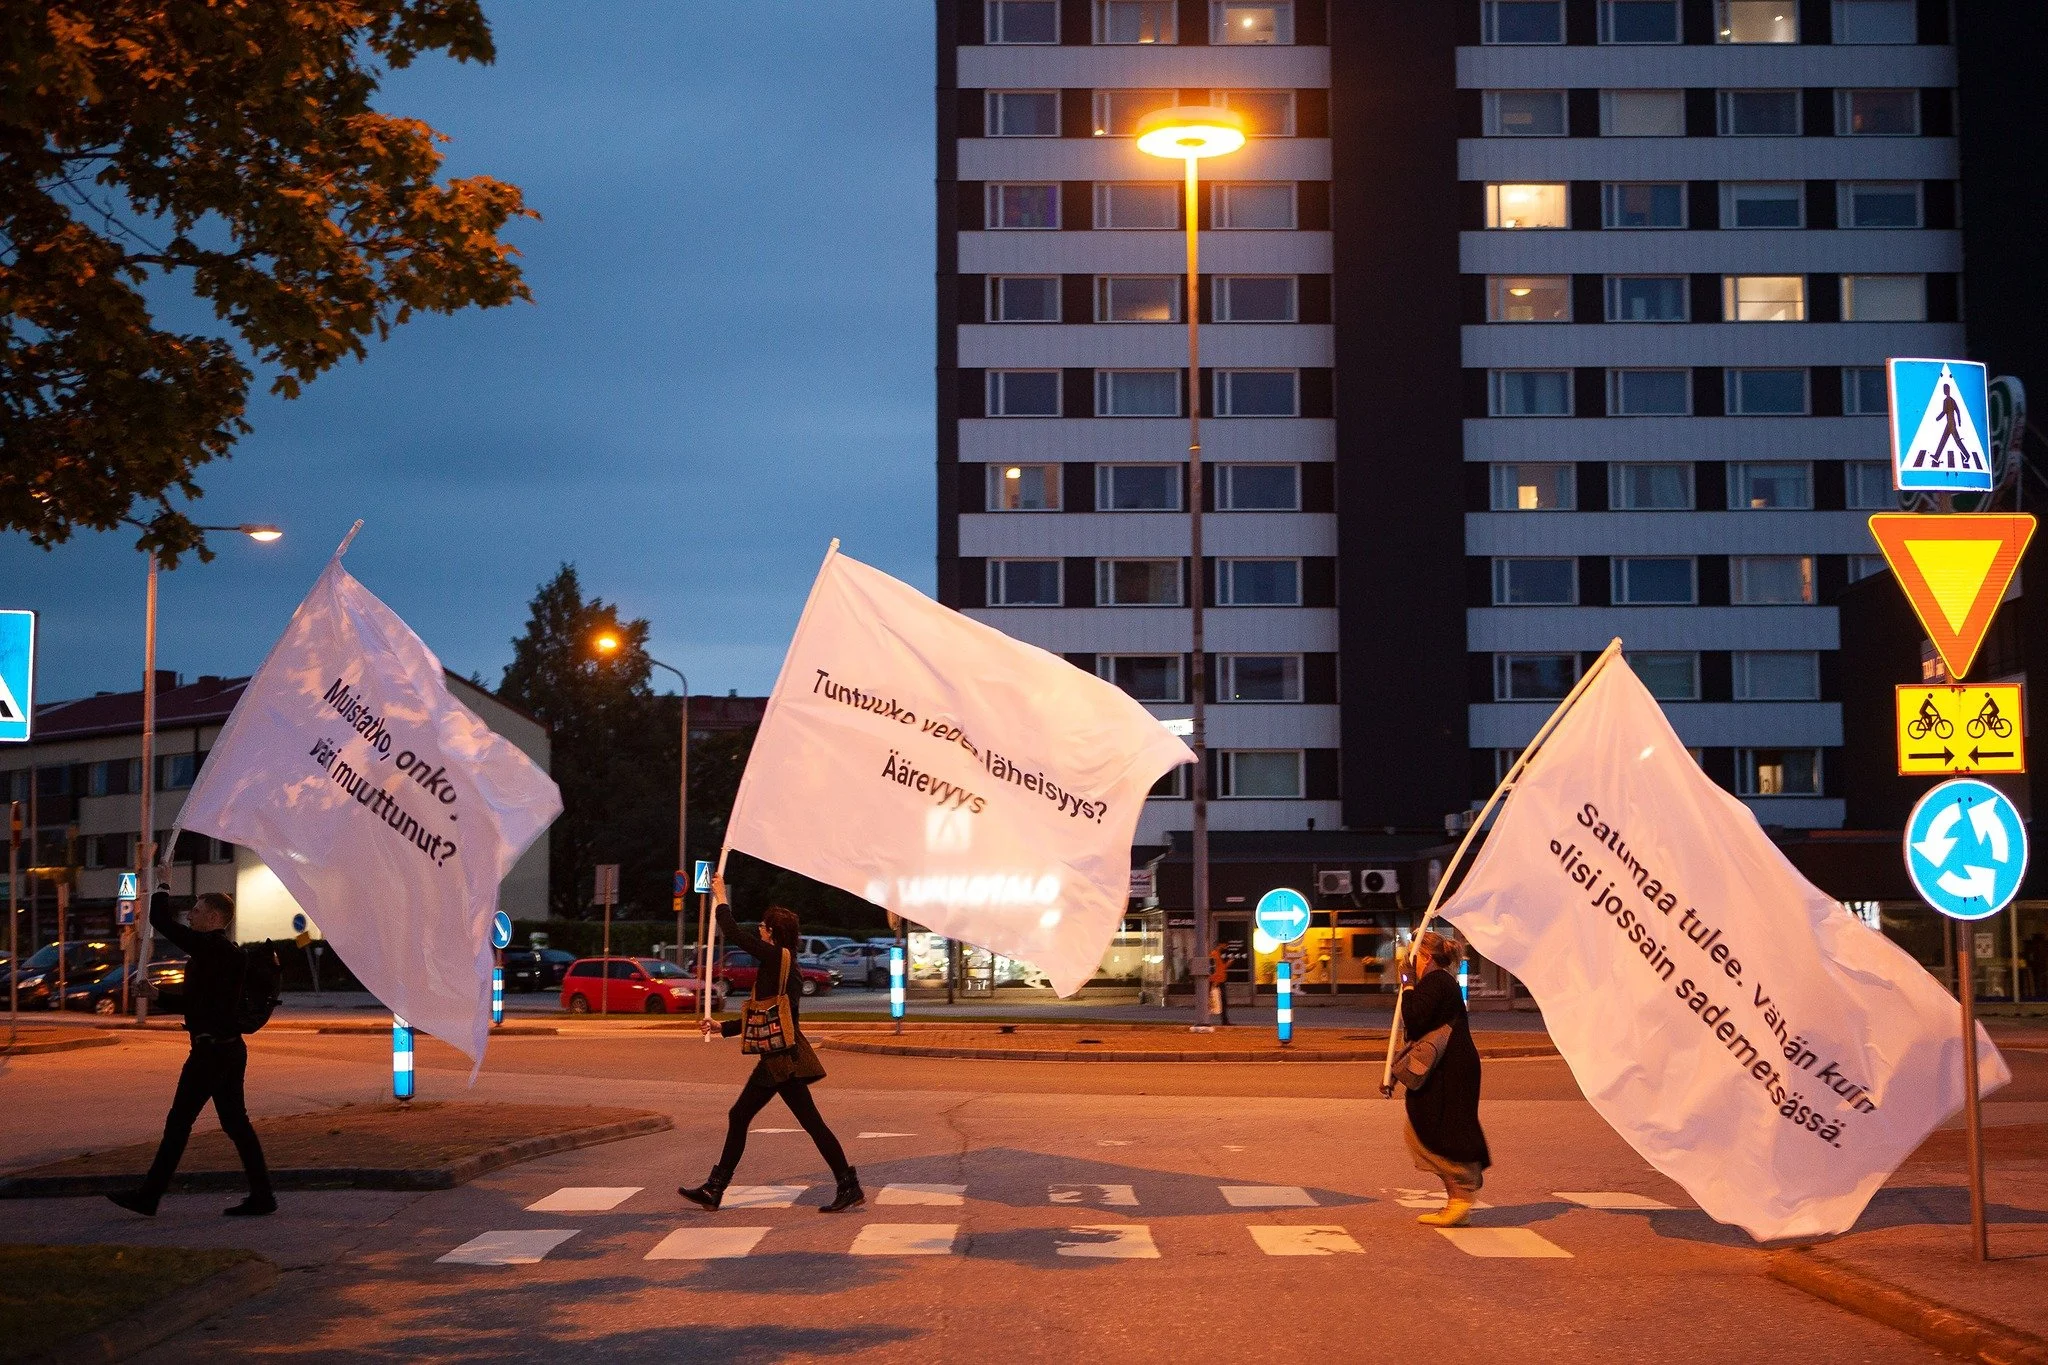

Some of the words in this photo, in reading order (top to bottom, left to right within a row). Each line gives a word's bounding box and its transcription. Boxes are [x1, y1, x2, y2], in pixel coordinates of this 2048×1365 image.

[323, 677, 391, 761] Muistatko,
[813, 669, 916, 725] Tuntuuko
[985, 750, 1107, 824] läheisyys?
[331, 760, 457, 867] muuttunut?
[882, 748, 987, 814] Äärevyys
[120, 902, 133, 922] P
[1577, 803, 1677, 916] Satumaa
[1678, 908, 1743, 987] tulee.
[1752, 983, 1819, 1070] Vähän
[1814, 1061, 1877, 1113] kuin
[1550, 839, 1602, 891] olisi
[1591, 882, 1675, 982] jossain
[1675, 978, 1846, 1148] sademetsässä.
